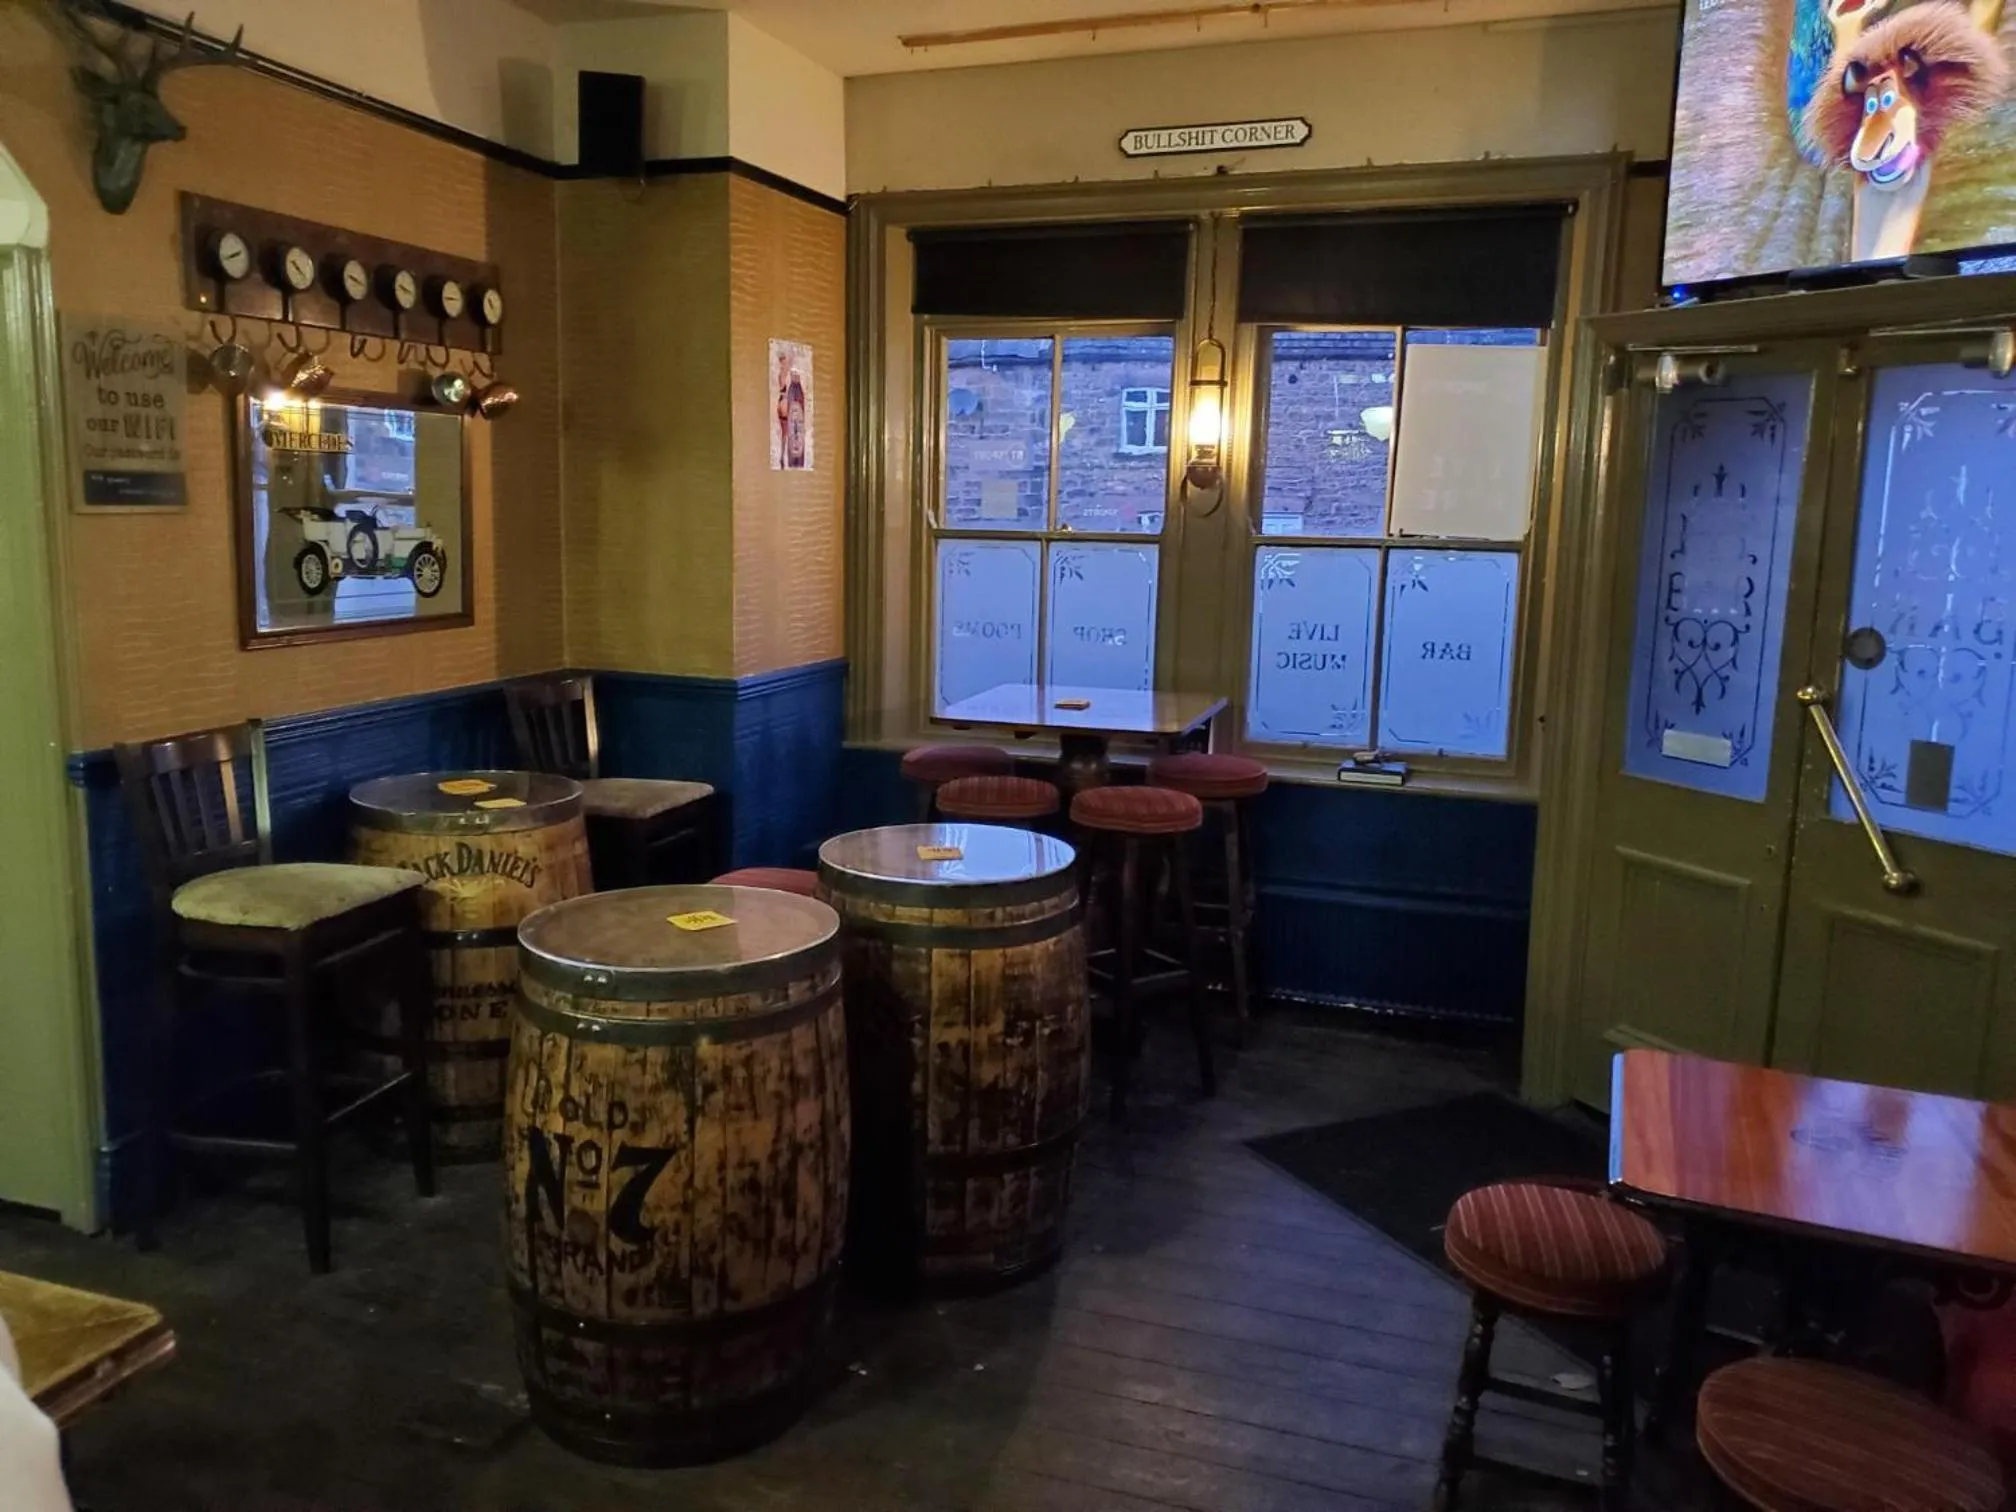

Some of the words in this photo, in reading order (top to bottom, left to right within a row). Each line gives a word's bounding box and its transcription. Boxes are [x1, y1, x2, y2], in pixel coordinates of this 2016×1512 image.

[1133, 129, 1217, 151] BULLSHIT
[1221, 124, 1296, 144] CORNER
[72, 329, 174, 380] Welcome
[98, 388, 119, 405] to
[125, 391, 165, 408] use
[86, 417, 120, 433] our
[271, 430, 354, 452] MERCEDES
[455, 842, 542, 888] DANIEL'S
[435, 1001, 509, 1021] ONE
[558, 1093, 630, 1130] OLD
